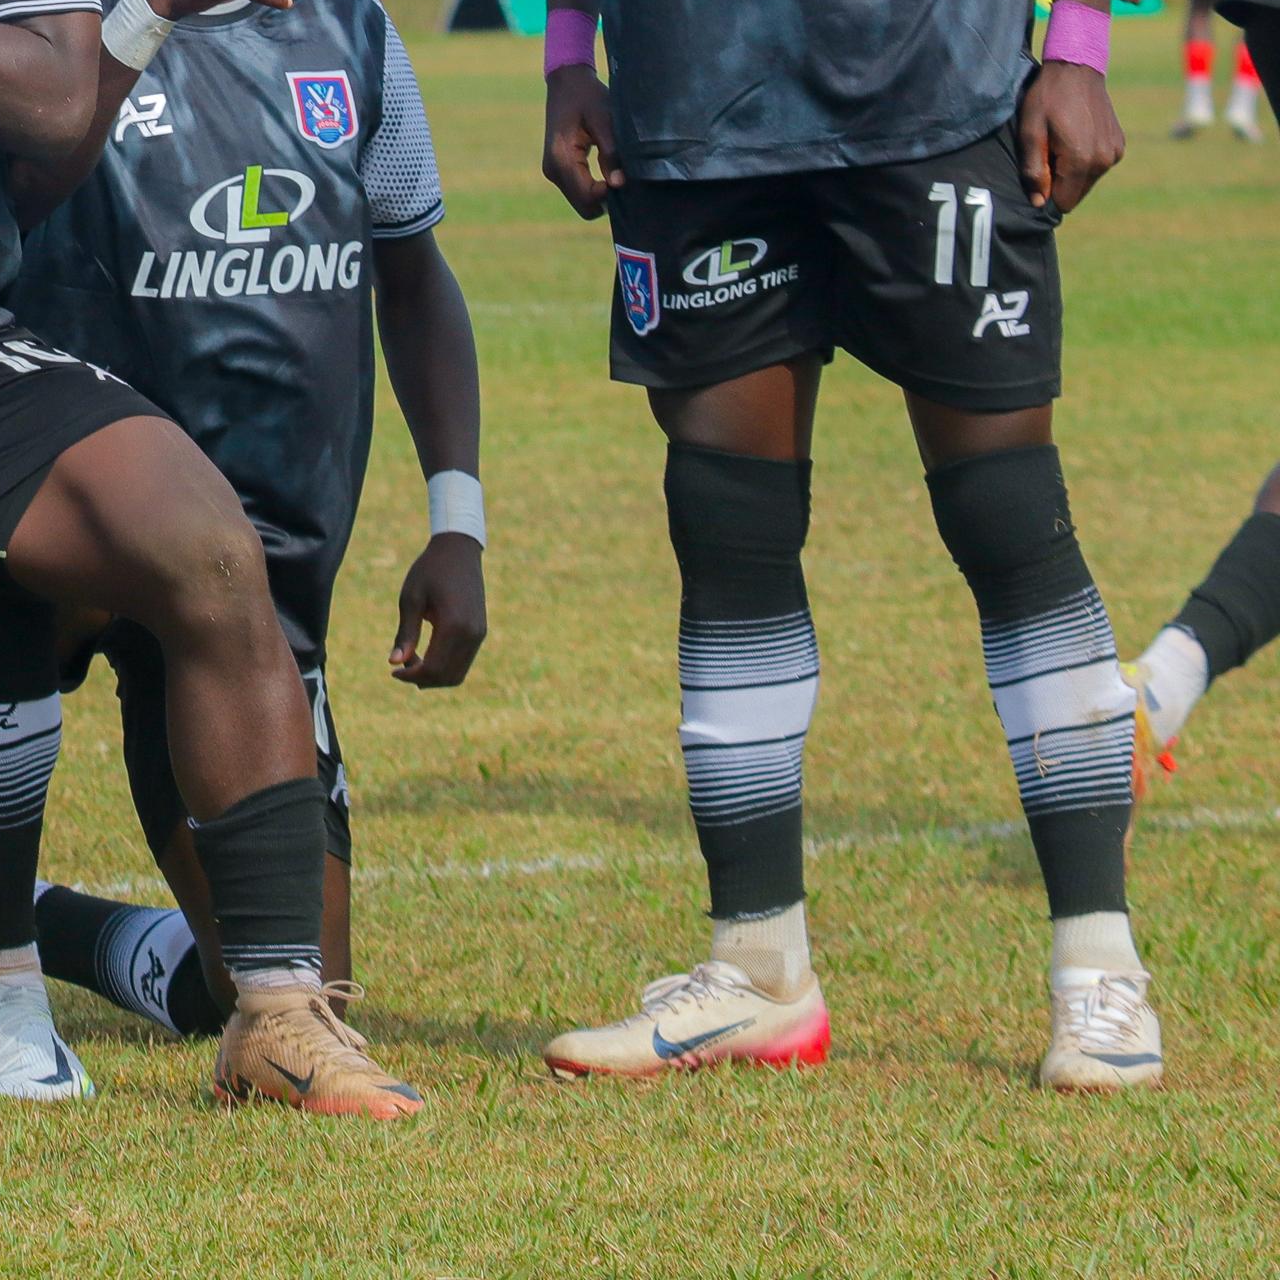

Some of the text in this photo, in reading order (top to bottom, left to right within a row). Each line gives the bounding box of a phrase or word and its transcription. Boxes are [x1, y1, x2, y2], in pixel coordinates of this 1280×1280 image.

[928, 181, 994, 288] 11
[131, 240, 364, 299] LINGLONG
[663, 263, 800, 310] LINGLONG TIRE
